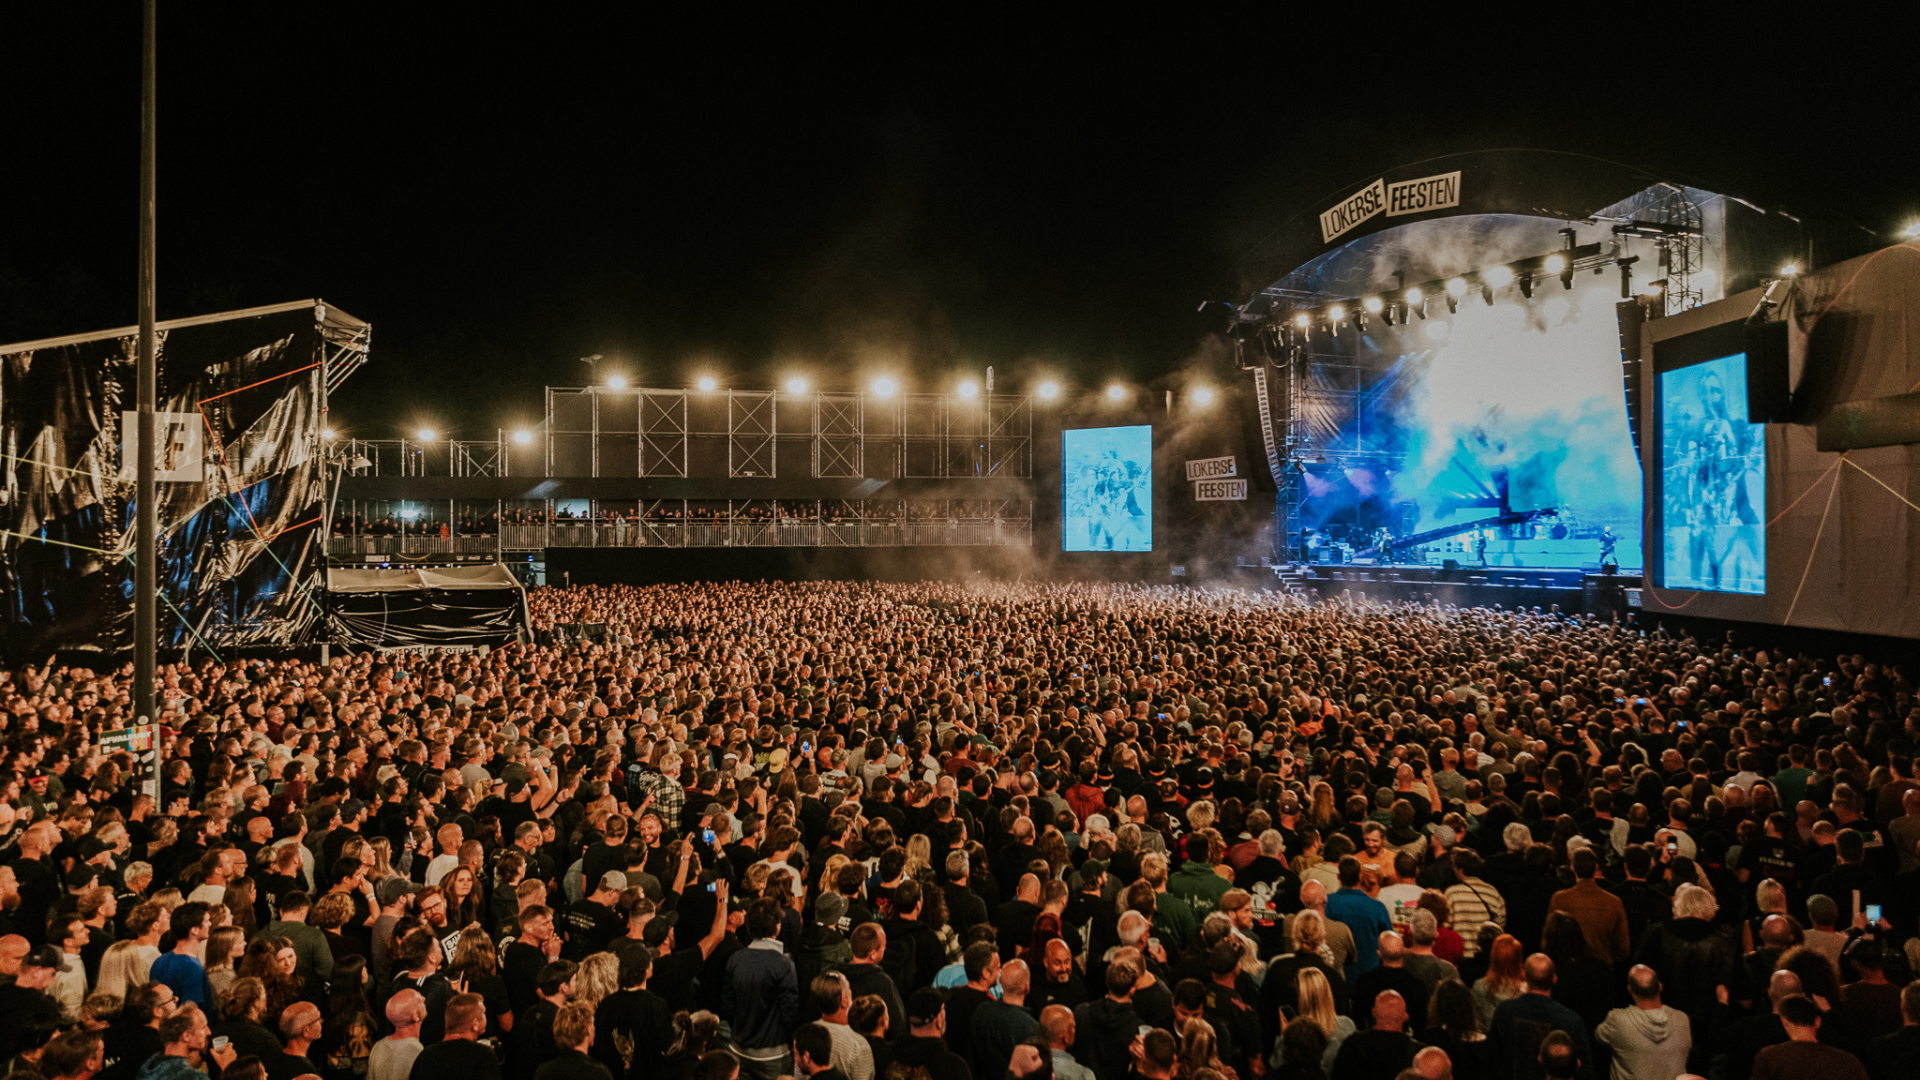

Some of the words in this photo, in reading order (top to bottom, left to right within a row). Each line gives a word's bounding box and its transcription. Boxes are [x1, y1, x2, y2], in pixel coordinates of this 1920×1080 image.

[1324, 184, 1383, 238] LOKERSE
[1390, 176, 1456, 212] FEESTEN
[1187, 459, 1234, 478] LOKERSE
[1198, 482, 1245, 498] FEESTEN
